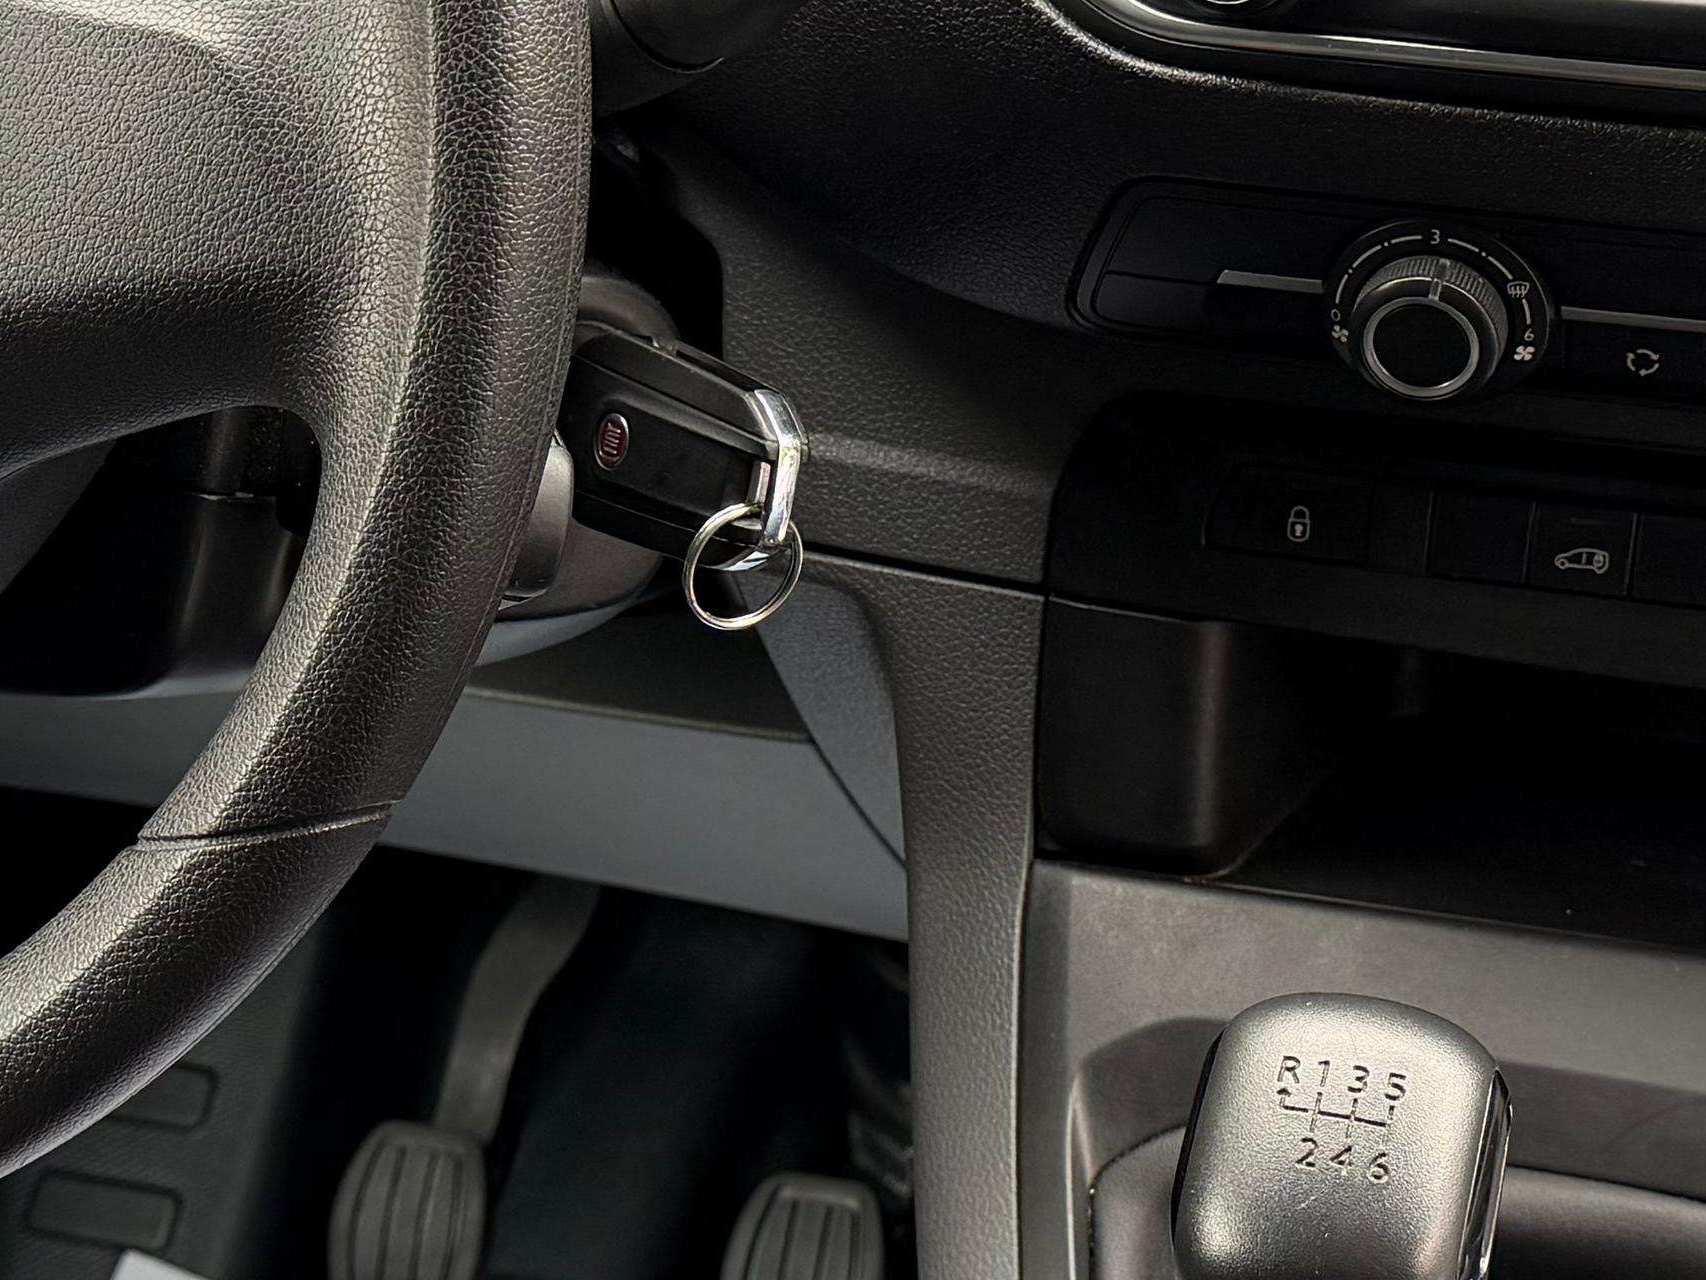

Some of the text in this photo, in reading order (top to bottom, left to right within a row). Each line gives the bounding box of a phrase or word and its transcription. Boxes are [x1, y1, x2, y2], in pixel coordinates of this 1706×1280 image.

[1430, 229, 1441, 245] 3
[1524, 328, 1535, 342] 6
[1277, 1055, 1407, 1101] R 1 3 5
[1295, 1137, 1391, 1185] 2 4 6
